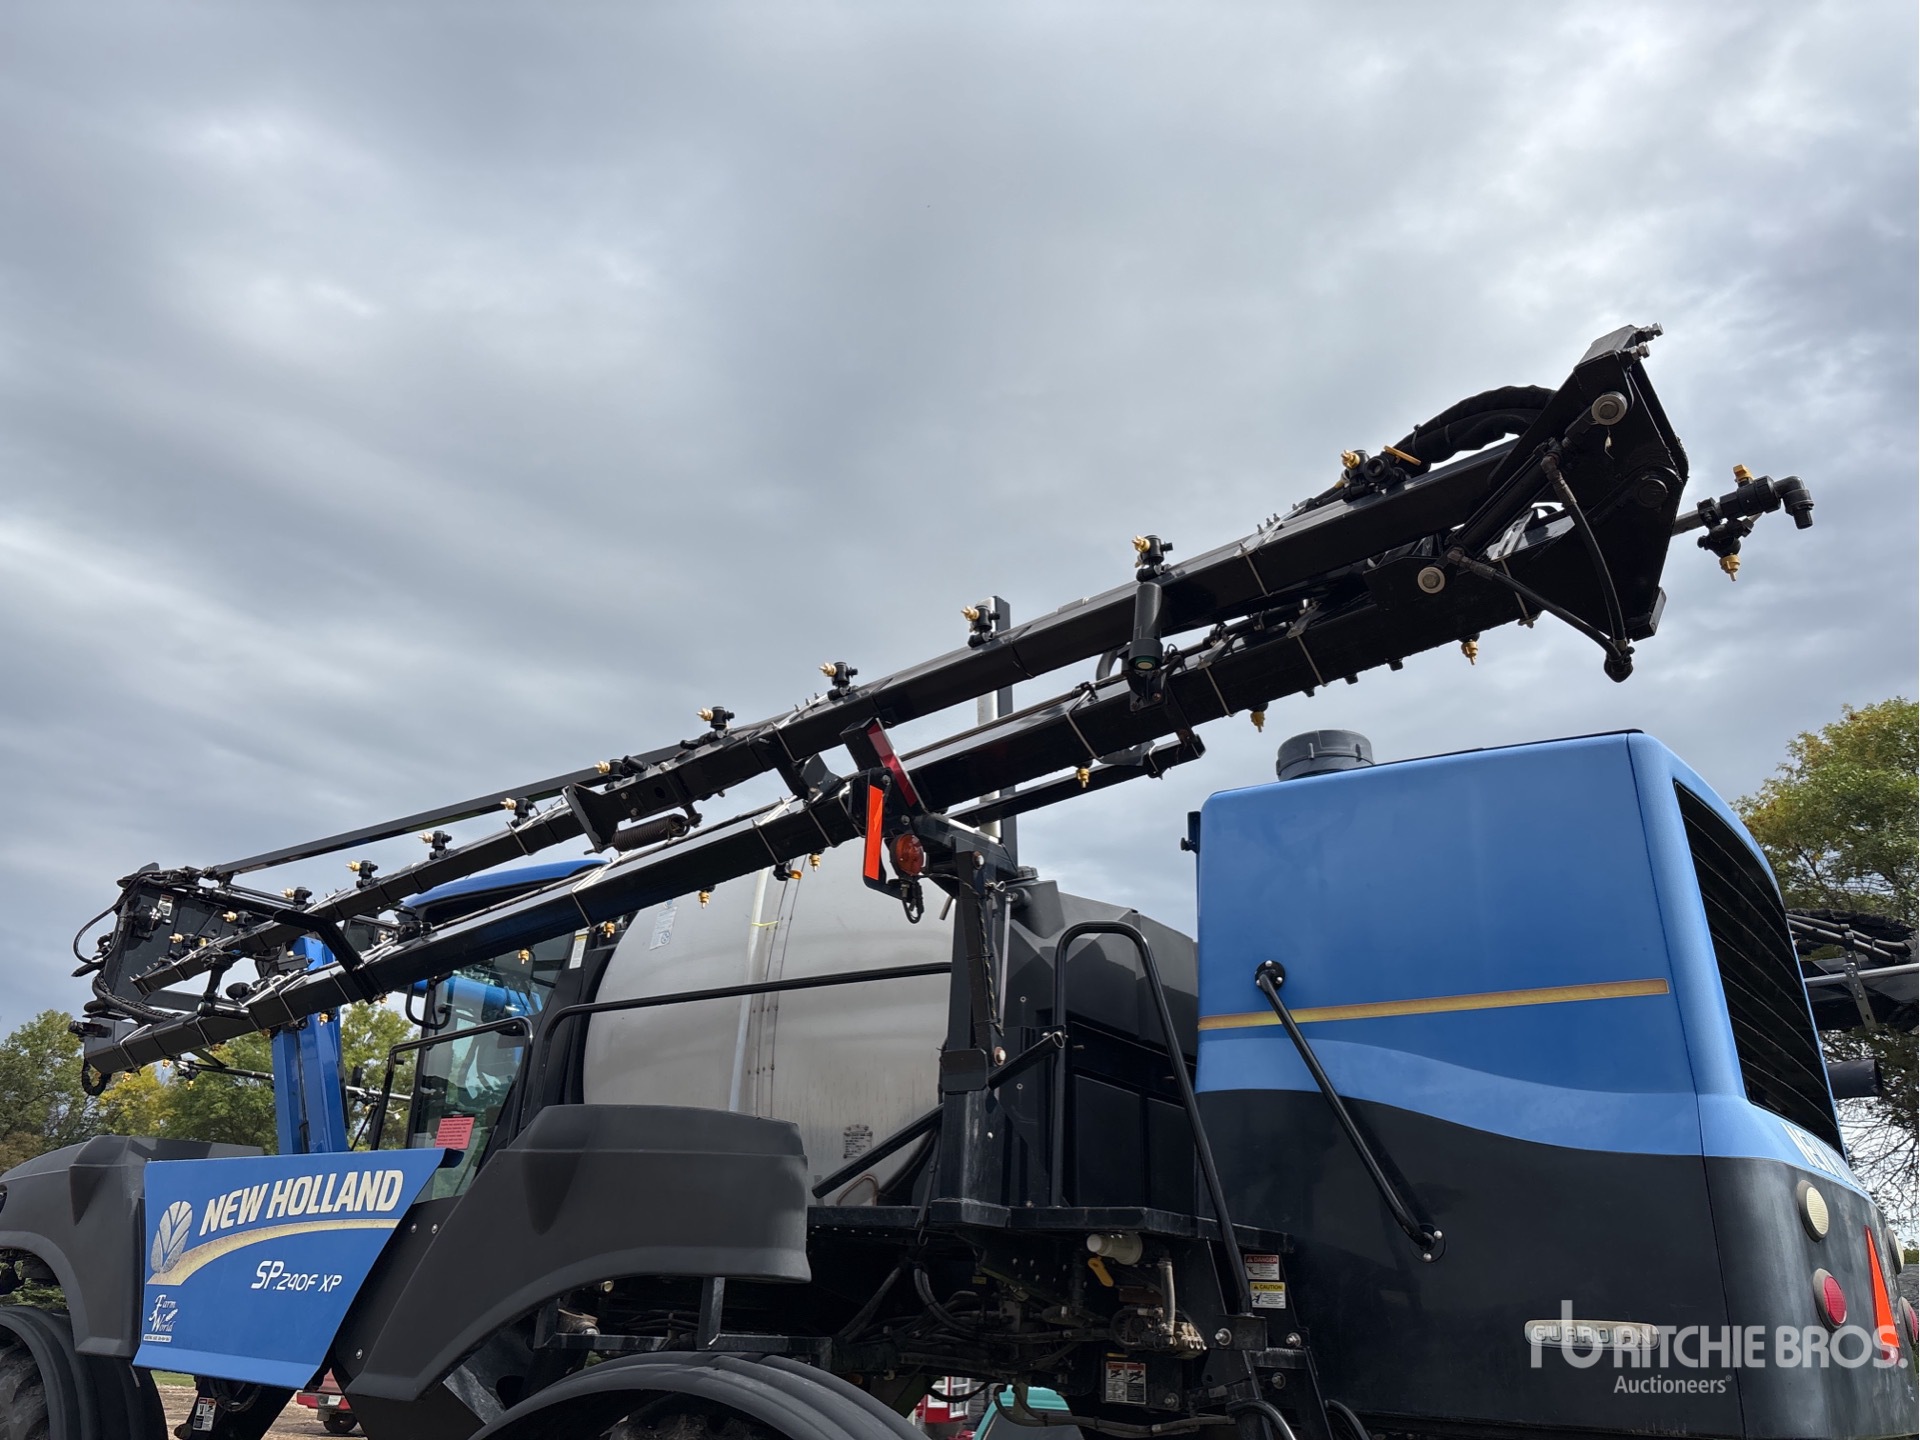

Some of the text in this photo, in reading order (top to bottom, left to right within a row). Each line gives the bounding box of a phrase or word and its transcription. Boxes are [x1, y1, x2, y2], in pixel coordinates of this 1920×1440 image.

[199, 1169, 404, 1236] NEW HOLLAND
[1253, 1255, 1278, 1263] DANGER
[318, 1273, 343, 1293] XP
[151, 1314, 177, 1332] World
[1533, 1325, 1652, 1346] GUARDIAN
